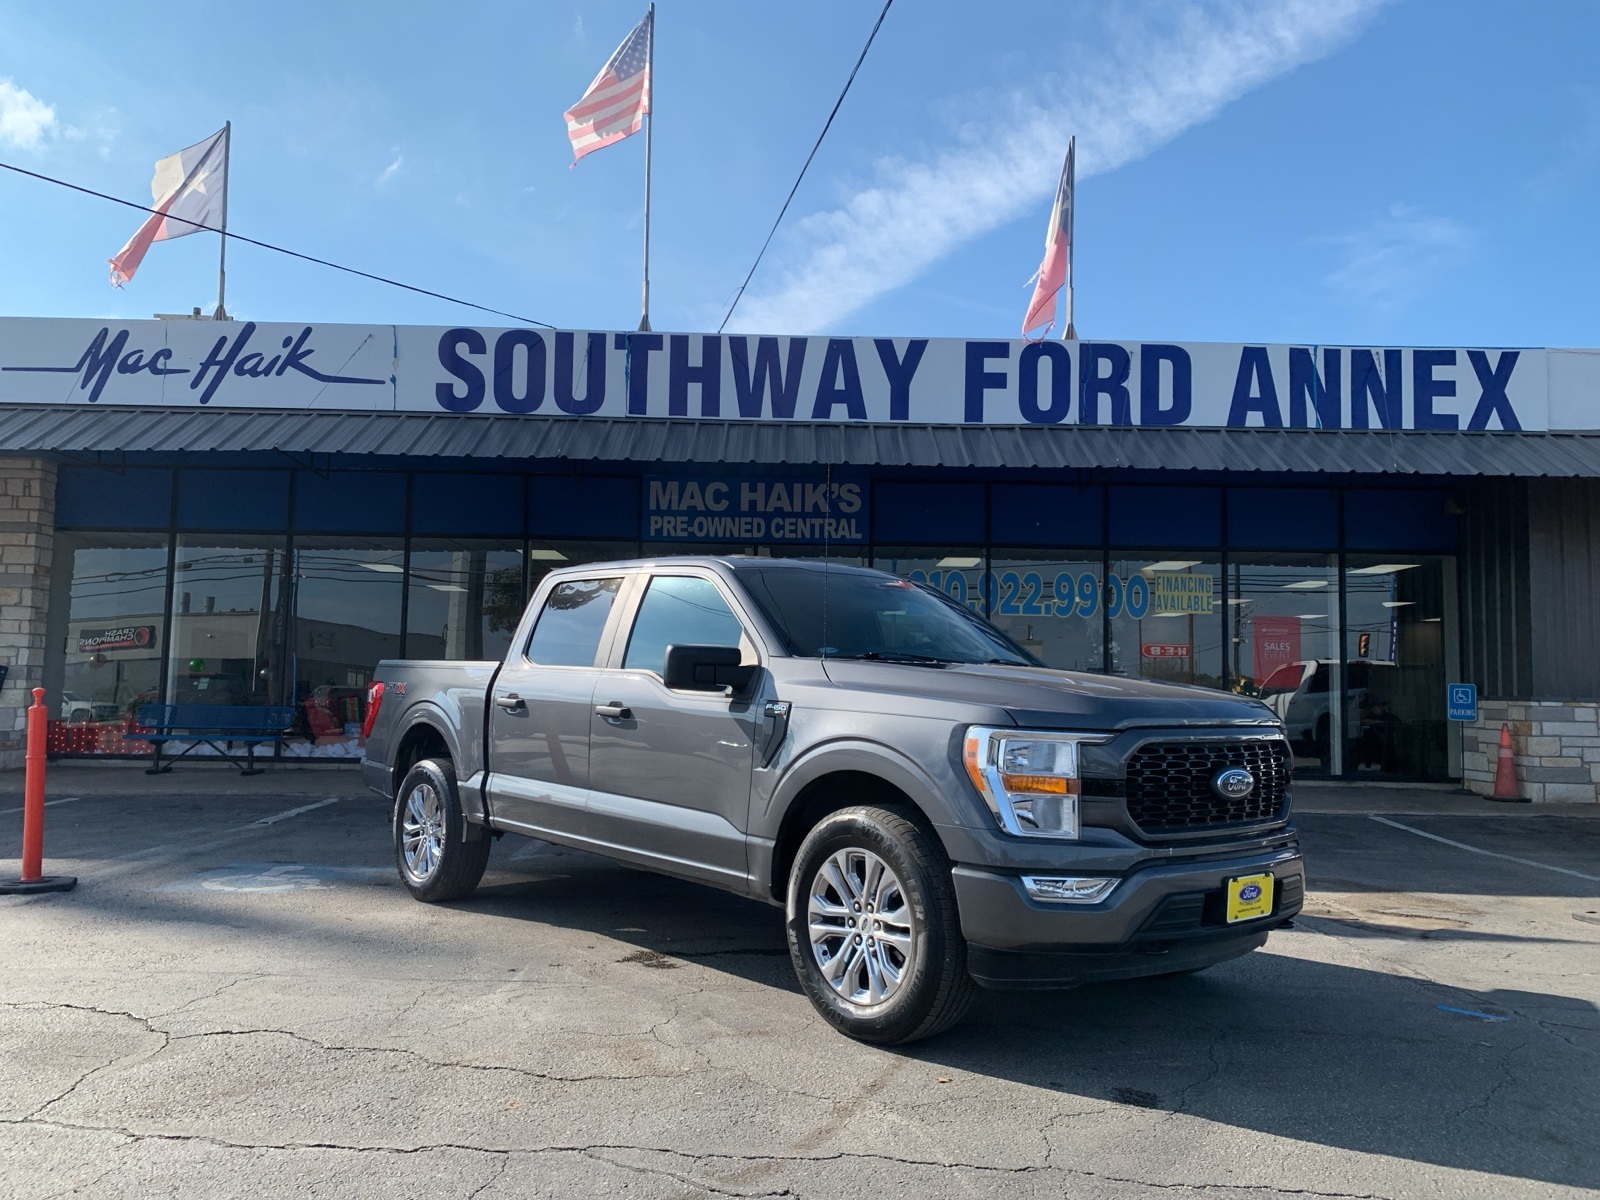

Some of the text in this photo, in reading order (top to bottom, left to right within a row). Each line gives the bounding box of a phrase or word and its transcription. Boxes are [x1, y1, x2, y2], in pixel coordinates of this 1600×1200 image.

[1, 321, 387, 405] Mac Haik
[435, 328, 1522, 432] SOUTHWAY FORD ANNEX
[650, 481, 862, 513] MAC HAIK'S
[650, 516, 862, 539] PRE-OWNED CENTRAL
[1156, 576, 1212, 593] FINANCING
[1156, 594, 1212, 611] AVAILABLE
[1264, 642, 1291, 651] SALES
[1264, 651, 1291, 659] EVENT
[1450, 708, 1476, 717] PARKING
[1228, 775, 1250, 791] Ford
[1242, 886, 1259, 899] Ford
